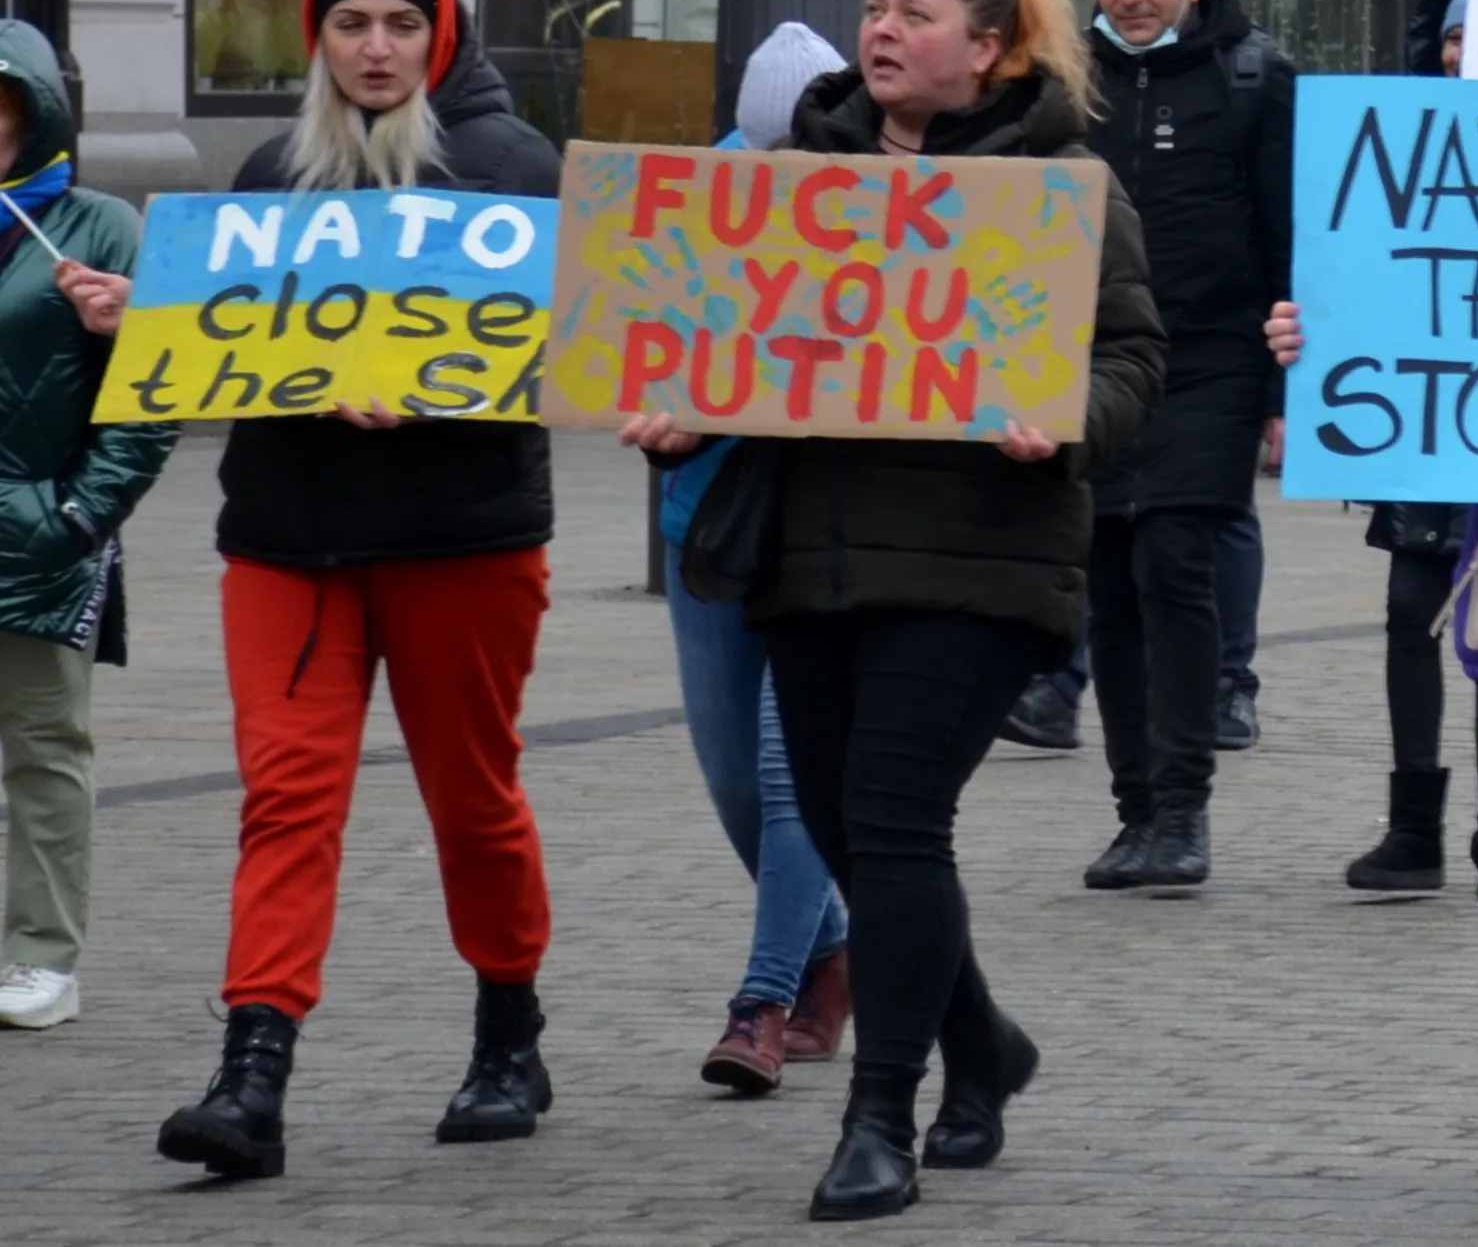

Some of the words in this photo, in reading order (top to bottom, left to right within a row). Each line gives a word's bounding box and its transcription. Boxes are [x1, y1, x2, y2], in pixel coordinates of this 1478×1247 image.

[207, 194, 536, 272] NATO
[629, 154, 955, 251] FUCK
[198, 270, 536, 347] close
[744, 257, 969, 343] YOU
[130, 348, 335, 414] the
[617, 320, 979, 424] PUTIN
